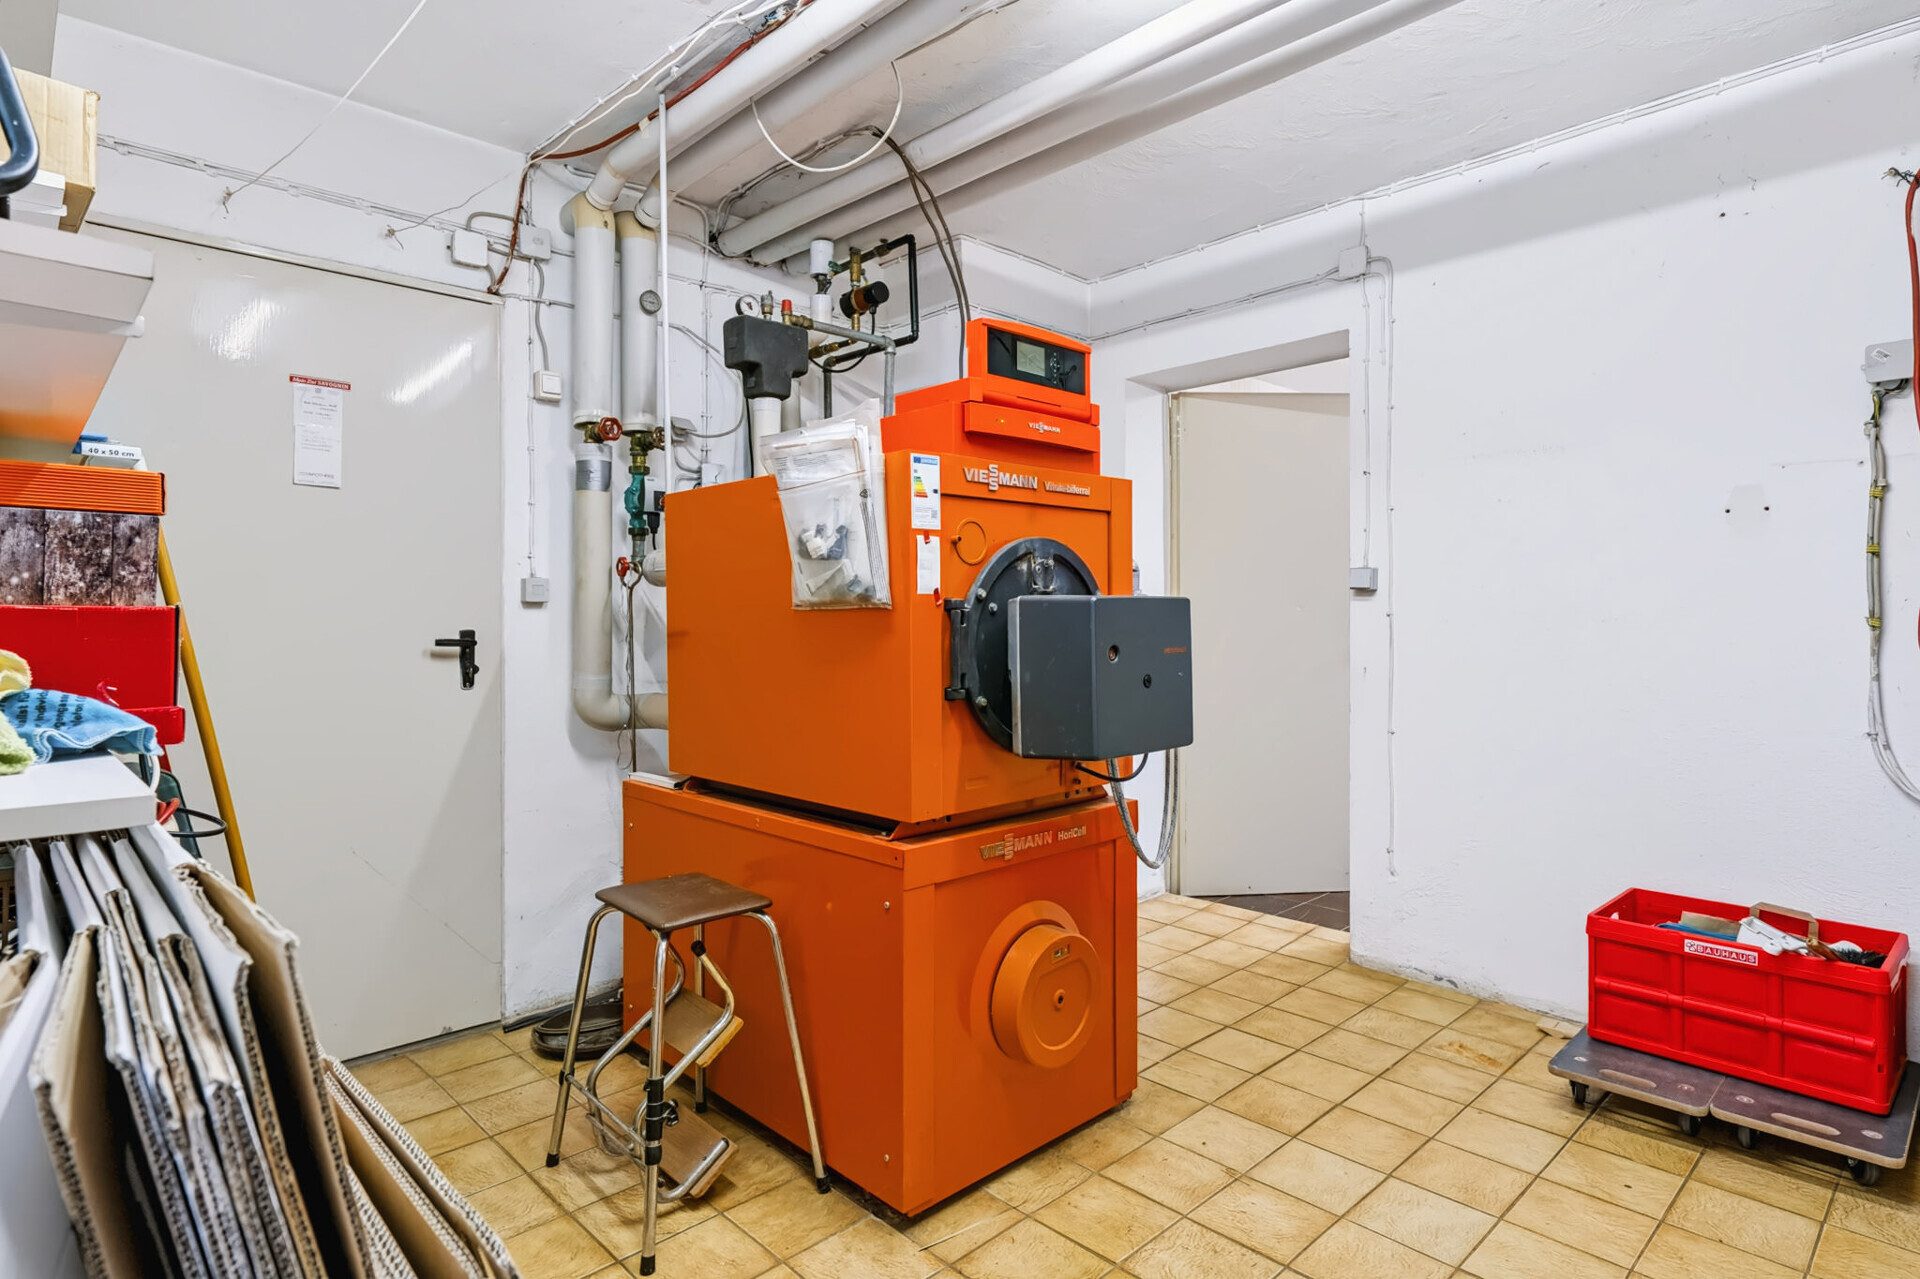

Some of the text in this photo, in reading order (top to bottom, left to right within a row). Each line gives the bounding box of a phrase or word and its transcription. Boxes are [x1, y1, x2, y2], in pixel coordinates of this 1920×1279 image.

[963, 463, 1038, 491] VIESSMANN
[980, 832, 1053, 860] VIESSMANN
[1697, 944, 1757, 964] BAUHAUS
